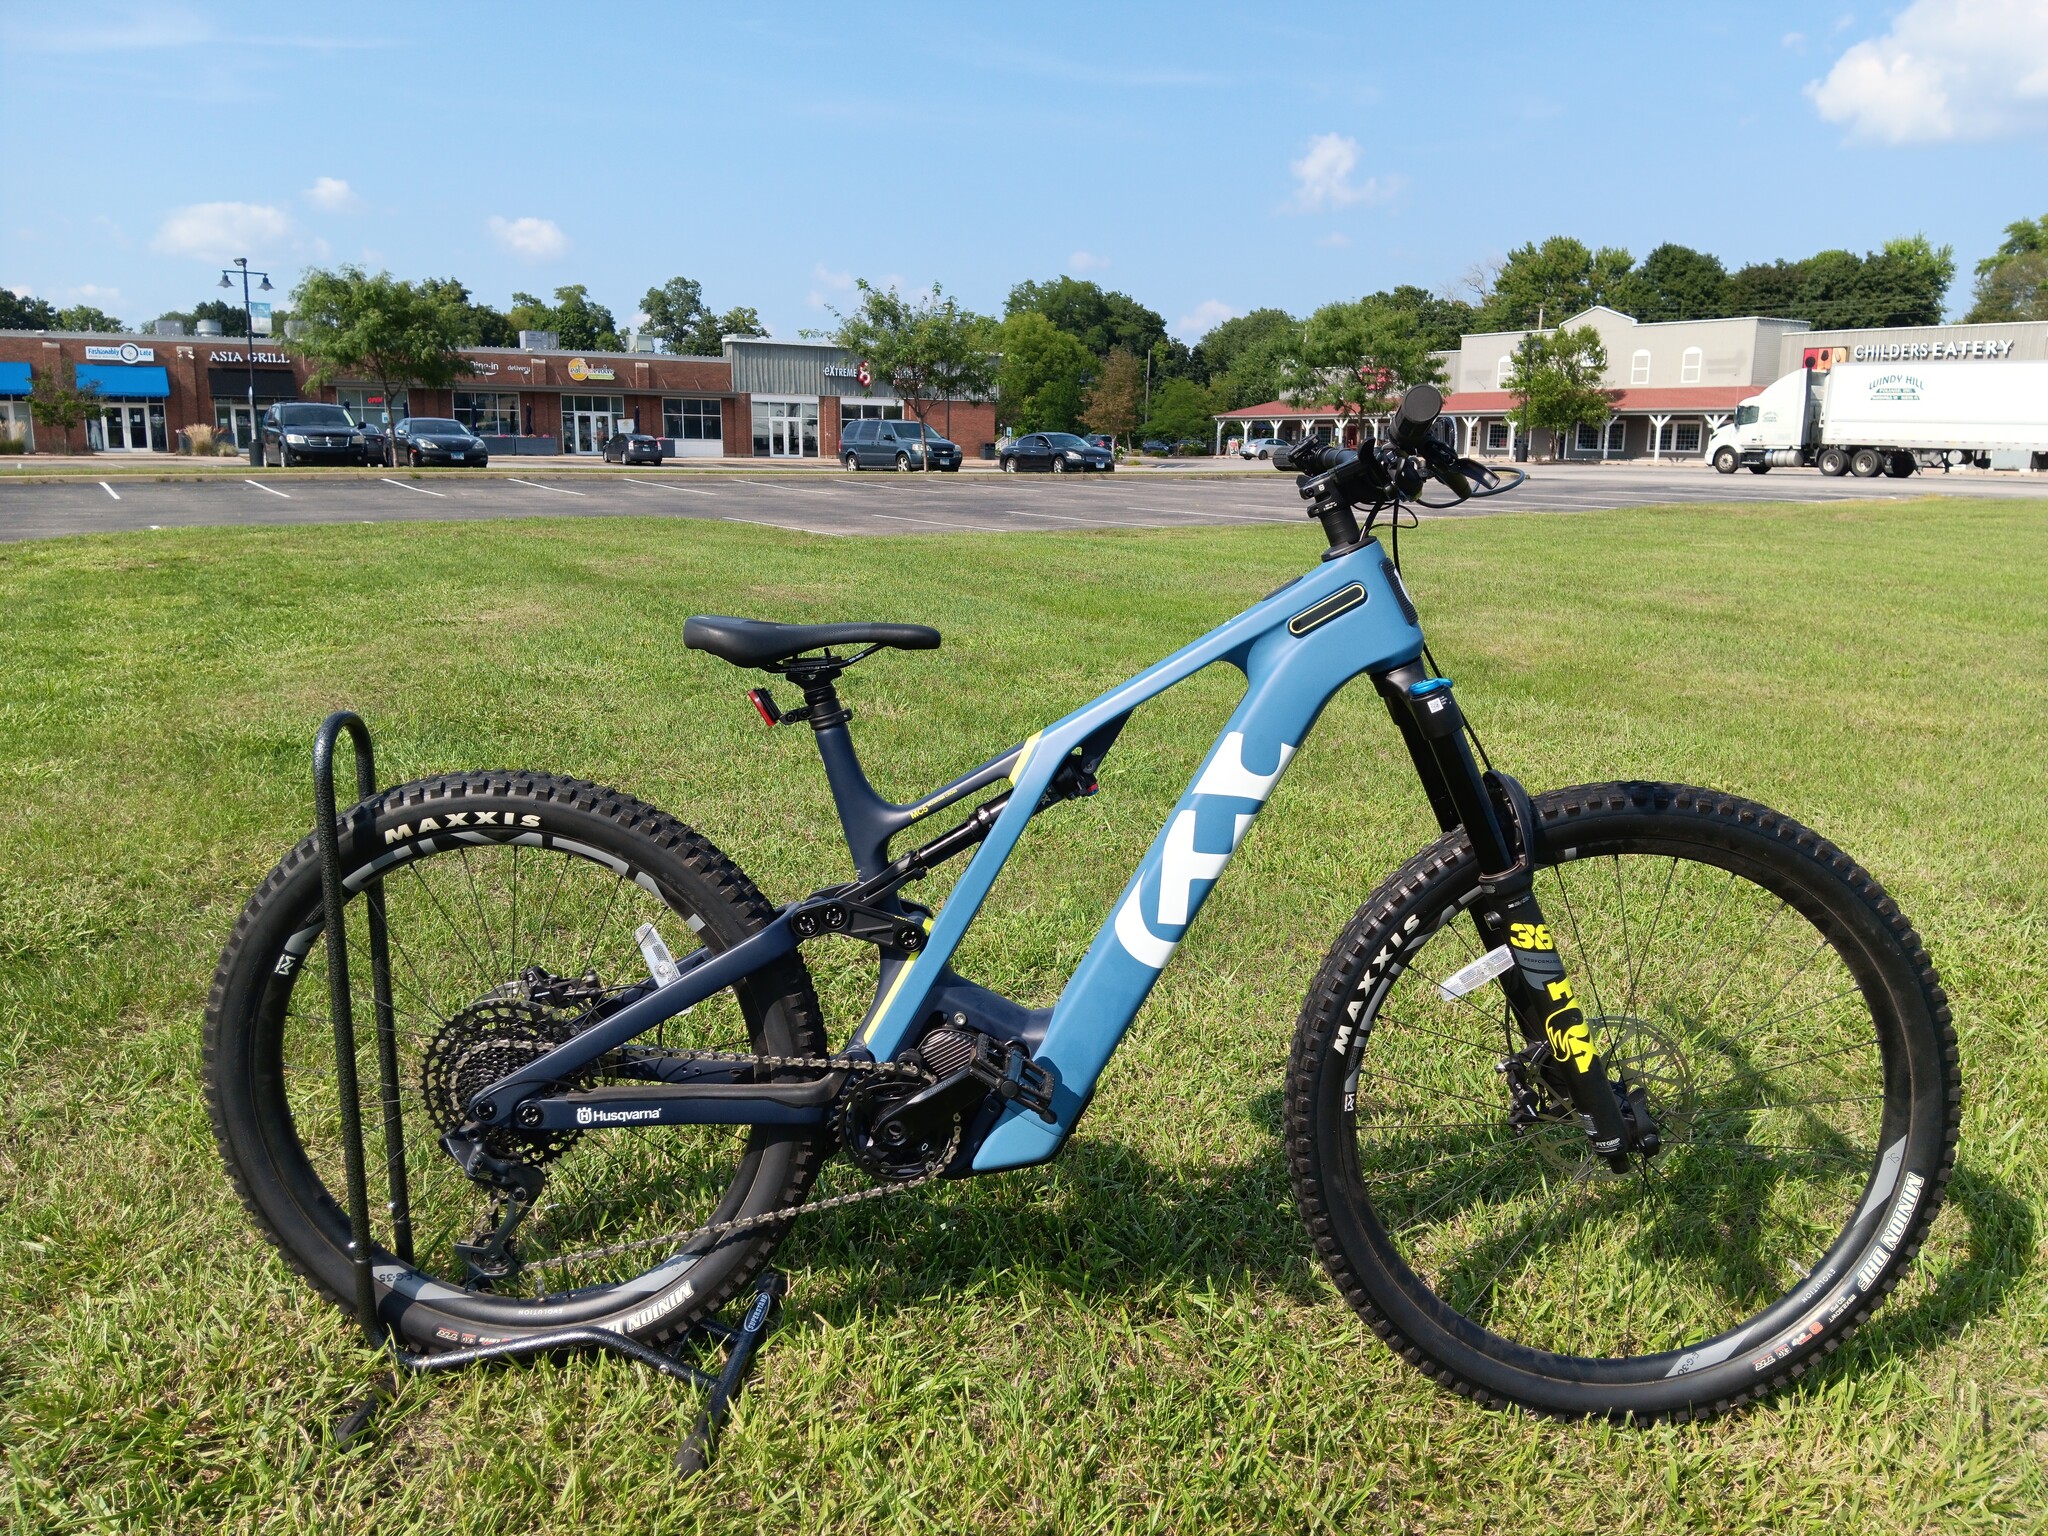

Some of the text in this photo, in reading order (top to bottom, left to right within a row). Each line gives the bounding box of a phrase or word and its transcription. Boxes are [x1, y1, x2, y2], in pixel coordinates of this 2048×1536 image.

[88, 348, 120, 356] Fashionably
[209, 351, 290, 364] ASIA GRILL
[1854, 339, 2014, 359] CHILDERS EATERY
[507, 364, 531, 375] delivery
[1869, 374, 1924, 391] WINDY HILL
[910, 804, 929, 819] MC5
[384, 811, 541, 846] MAXXIS
[1510, 922, 1554, 950] 36
[1524, 957, 1561, 965] PERFORMANC
[1333, 914, 1420, 1056] MAXXIS
[1546, 976, 1600, 1074] FOX
[593, 1108, 661, 1122] Husqvarna
[1857, 1171, 1925, 1292] MINION DHF
[1802, 1268, 1836, 1303] EVOLUTION
[518, 1307, 564, 1316] EVOLUTION
[626, 1279, 695, 1334] MINION
[747, 1293, 768, 1330] SUPERSTAND
